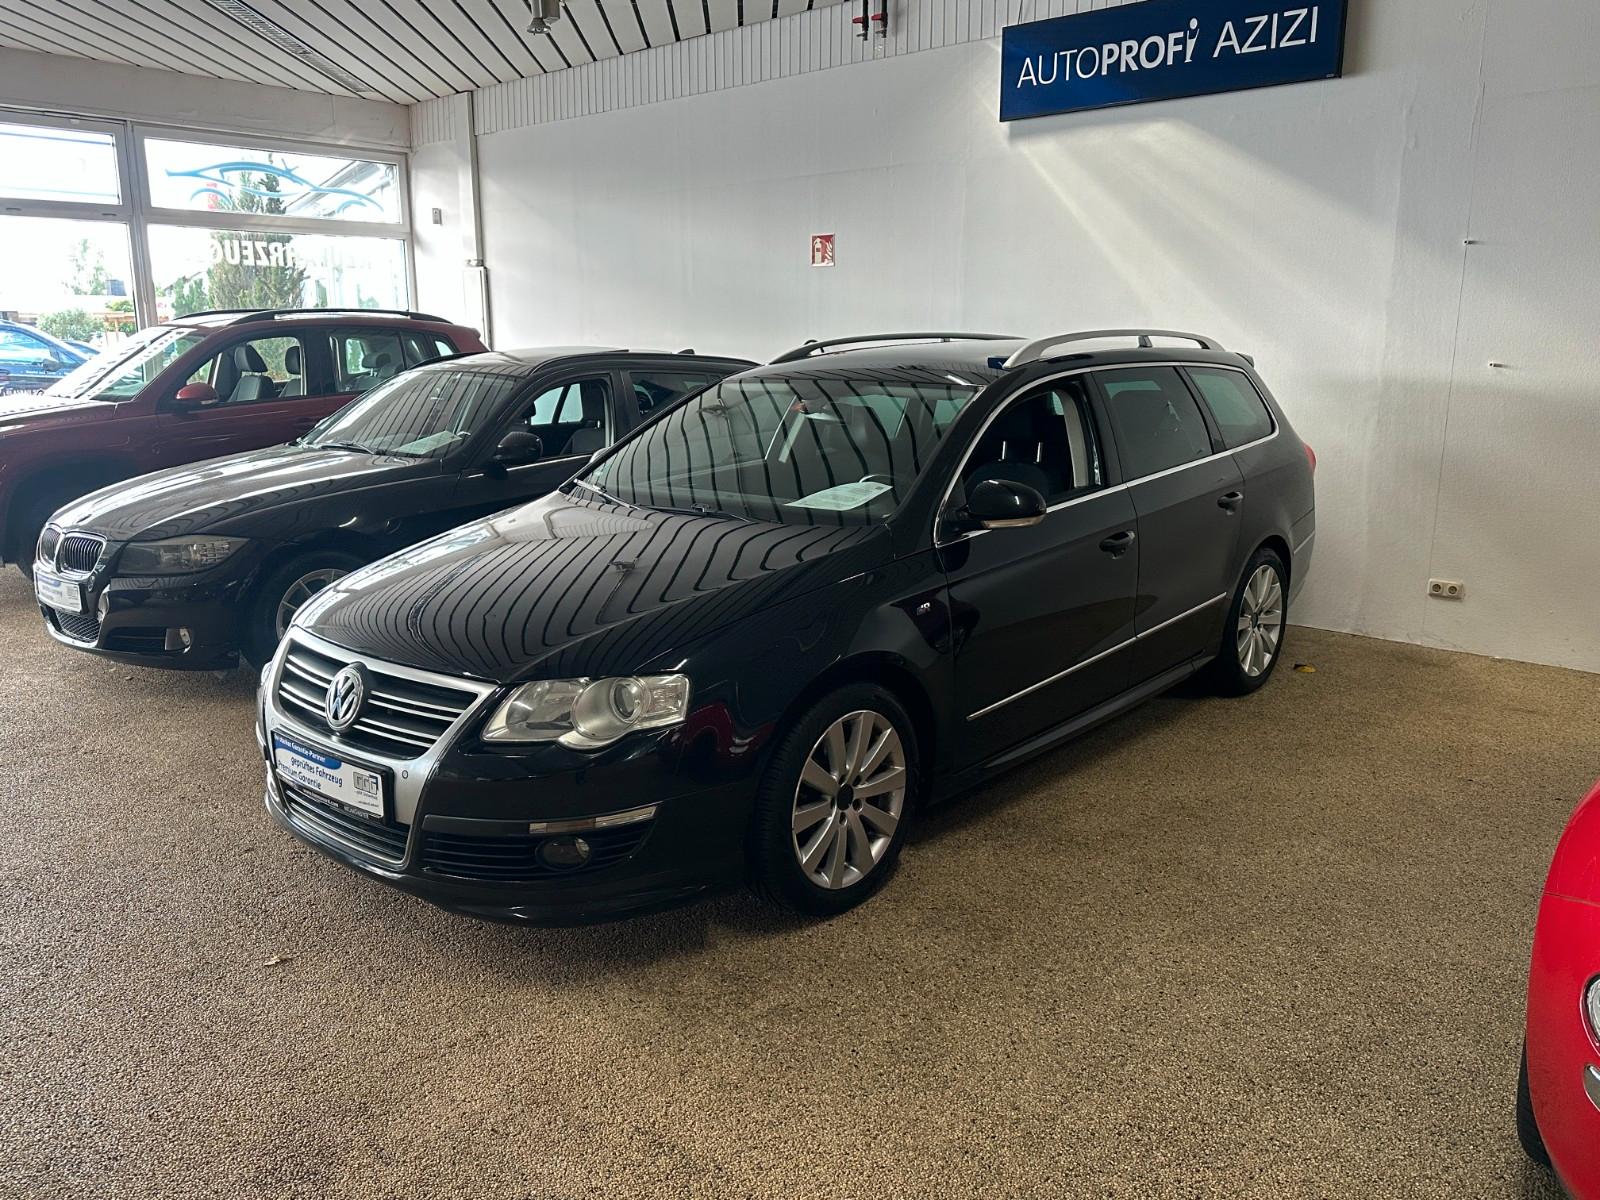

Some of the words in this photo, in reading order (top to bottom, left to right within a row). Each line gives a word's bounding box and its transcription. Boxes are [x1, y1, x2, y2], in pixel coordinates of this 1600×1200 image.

[1212, 6, 1319, 58] AZIZI
[290, 756, 315, 774] geprüftes
[315, 766, 343, 788] Fahrzeug
[298, 771, 322, 790] Garantie
